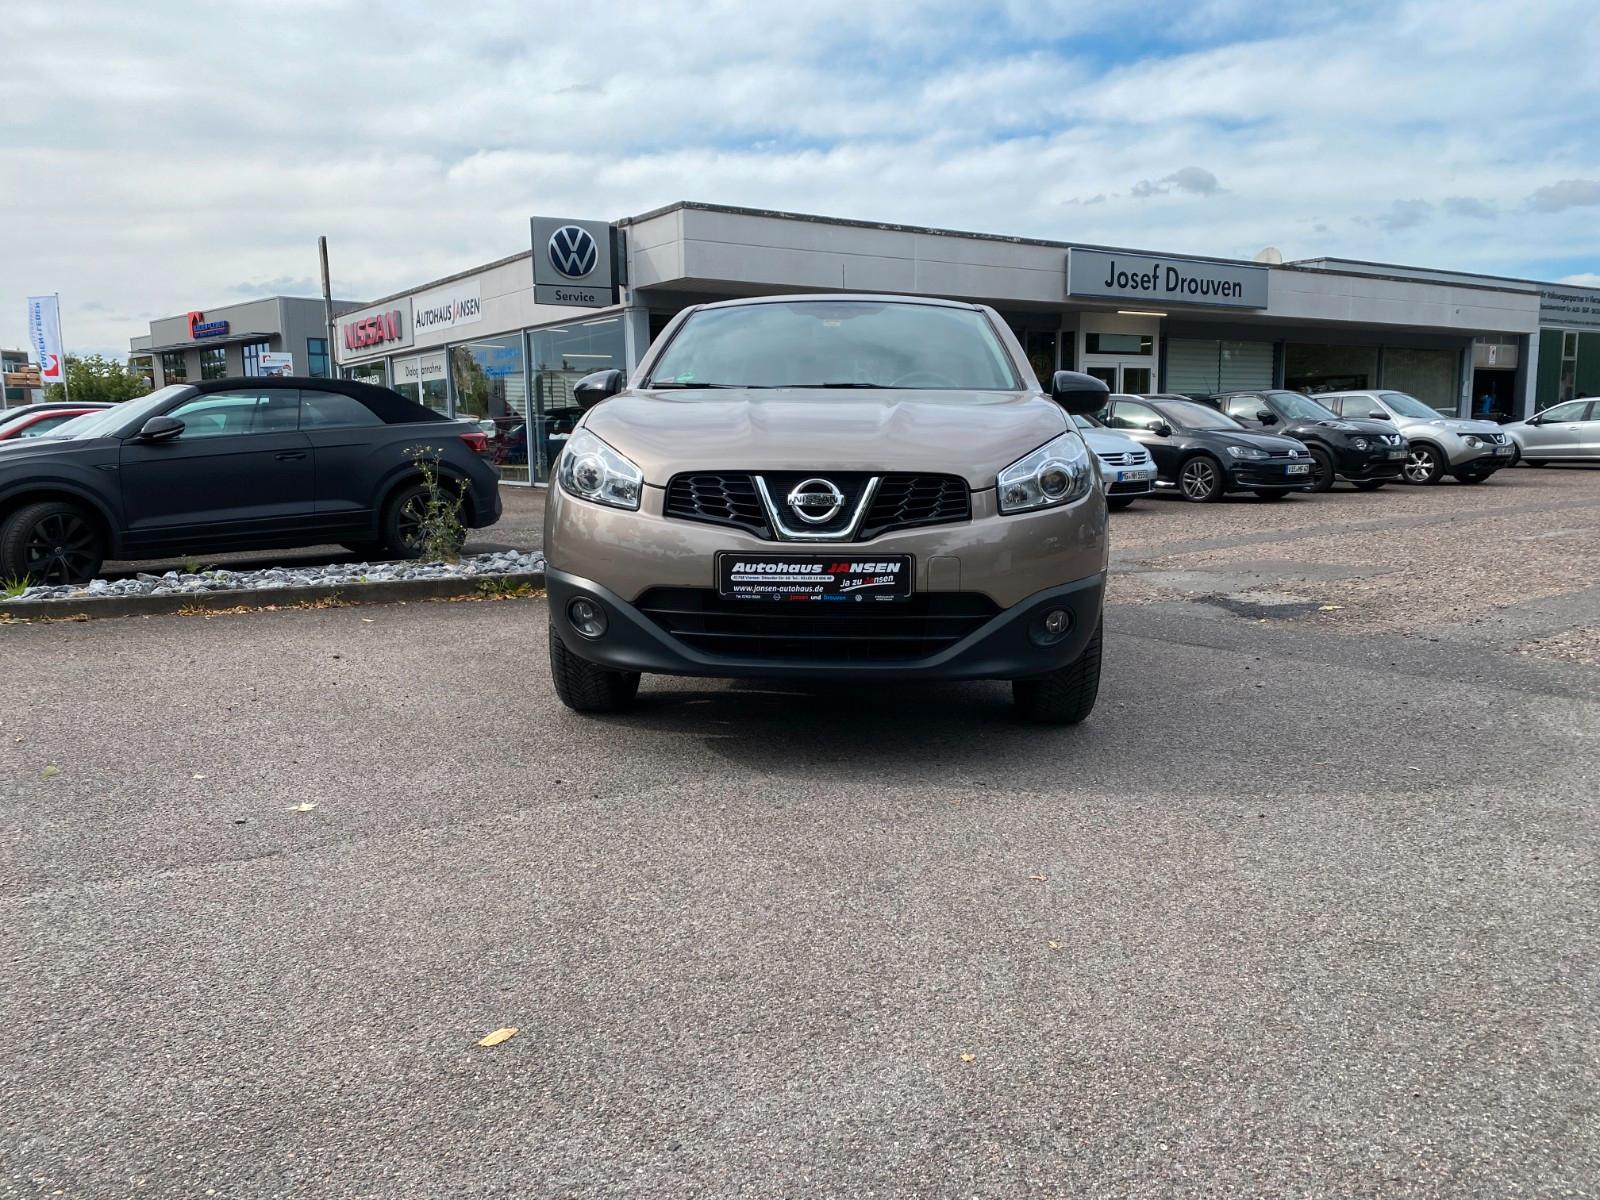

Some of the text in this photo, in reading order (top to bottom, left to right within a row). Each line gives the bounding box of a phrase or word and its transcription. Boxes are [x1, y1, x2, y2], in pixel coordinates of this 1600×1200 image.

[1105, 261, 1242, 298] Josef Drouven
[555, 290, 595, 302] Service
[416, 297, 480, 328] AUTOHAUS JANSEN
[344, 310, 402, 350] NISSAN
[788, 493, 845, 506] NISSAN
[731, 562, 901, 573] Autohaus JANSEN
[840, 575, 894, 587] Ja zu Jansen
[733, 584, 824, 593] www.jansen-autohaus.de
